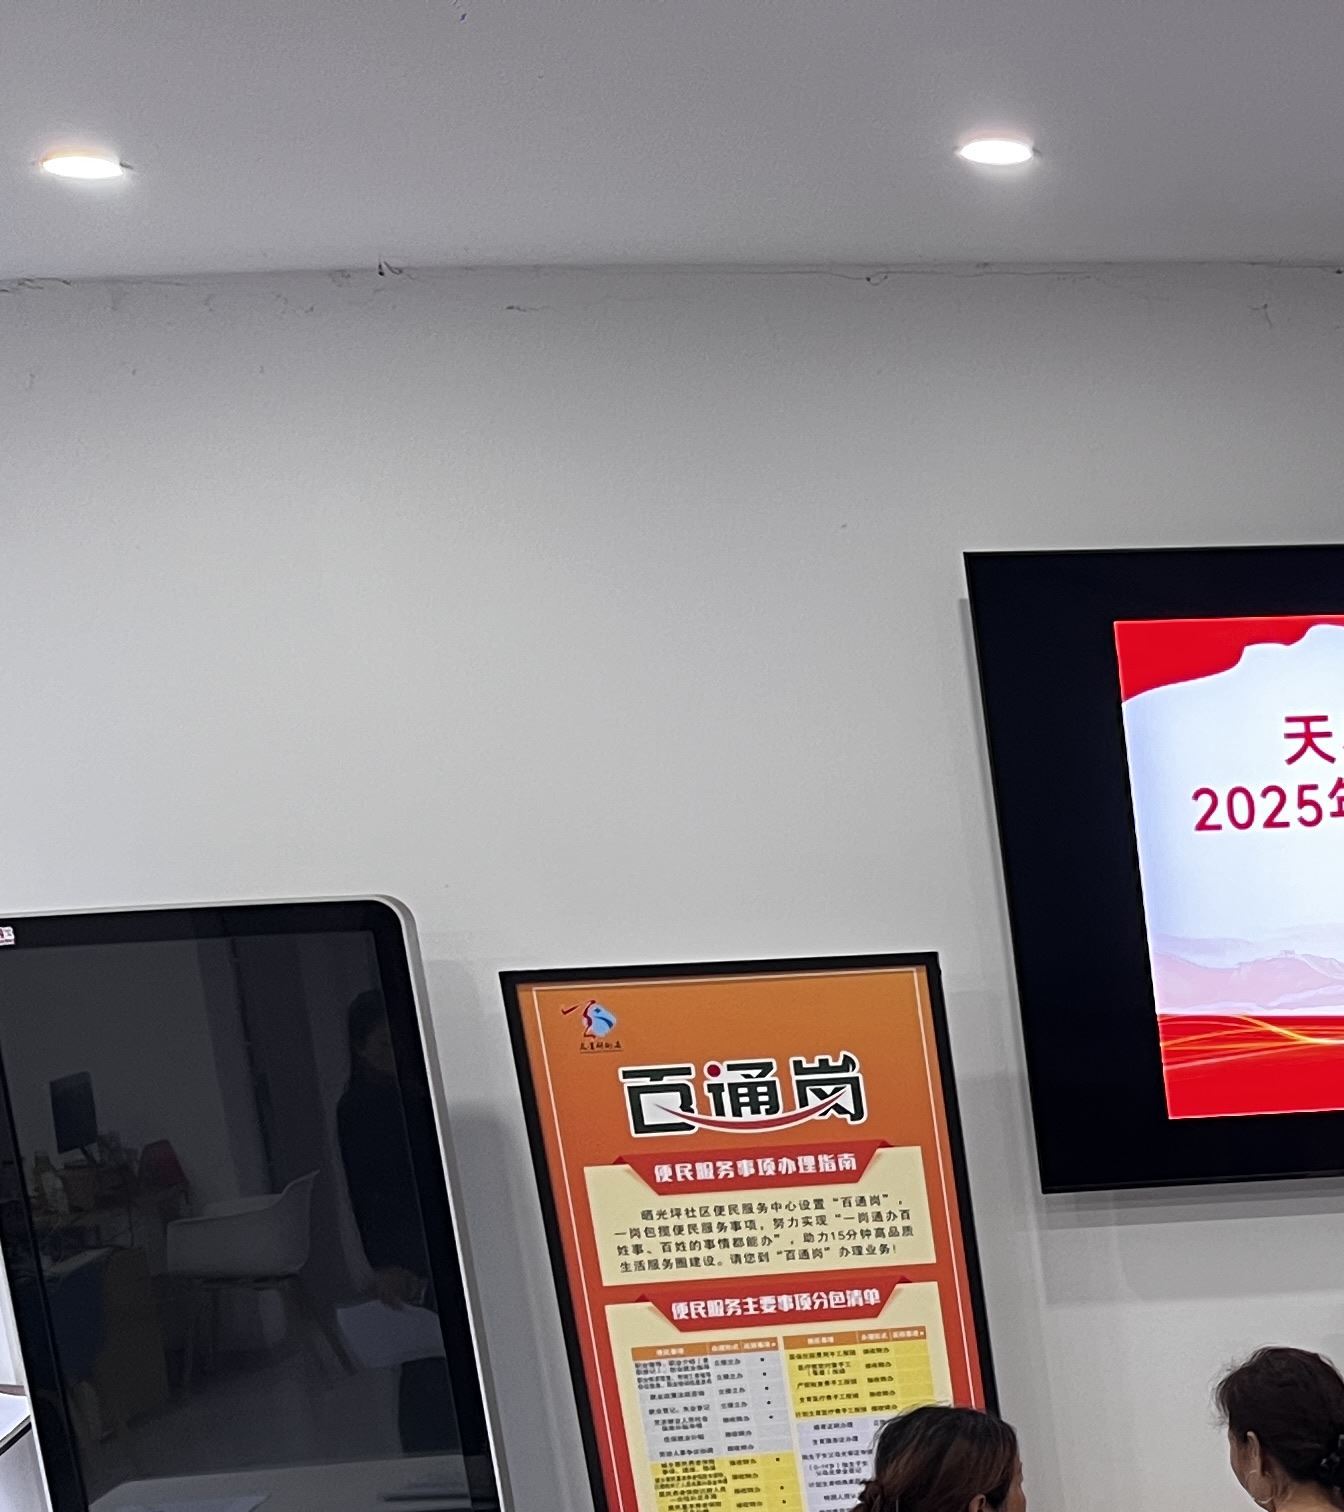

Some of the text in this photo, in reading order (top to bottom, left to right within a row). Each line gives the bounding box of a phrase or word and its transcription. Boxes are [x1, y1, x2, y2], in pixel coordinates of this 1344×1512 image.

[620, 1052, 865, 1136] 百通岗
[654, 1153, 857, 1183] 便民服务事项办理指南
[671, 1288, 880, 1320] 便民服务主要事项分色清单
